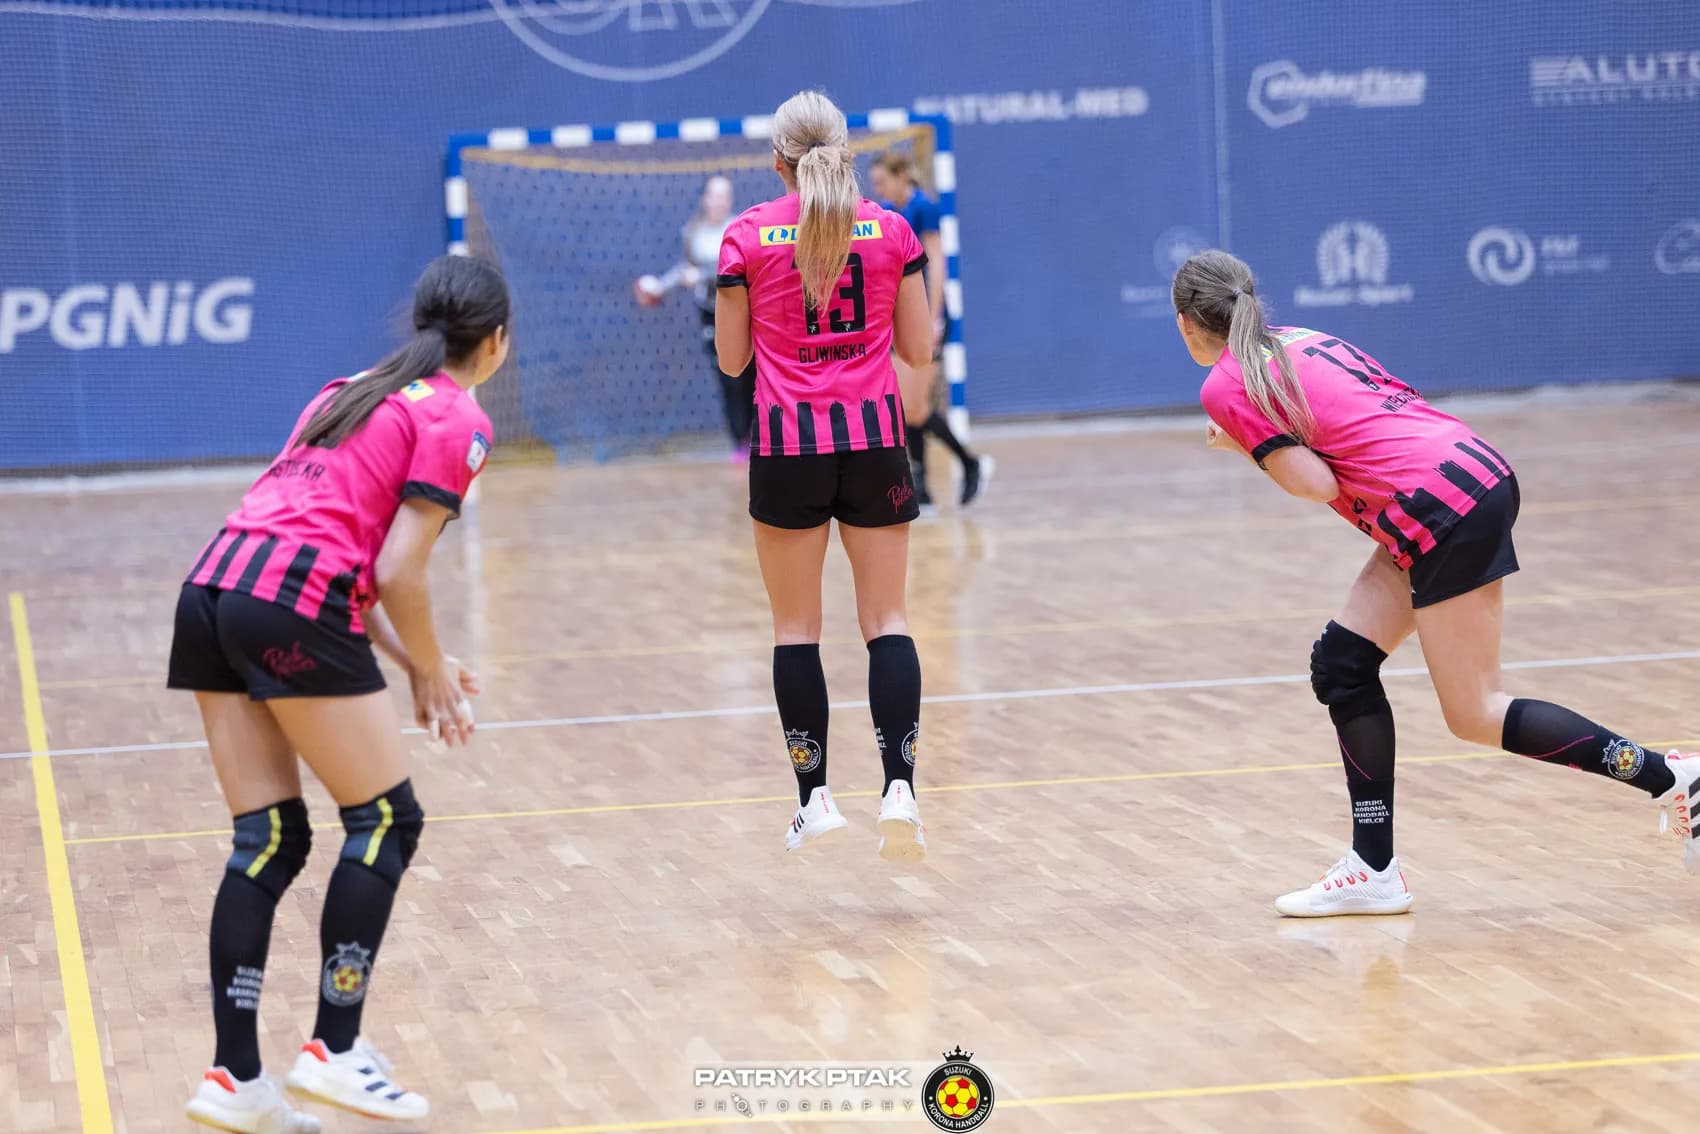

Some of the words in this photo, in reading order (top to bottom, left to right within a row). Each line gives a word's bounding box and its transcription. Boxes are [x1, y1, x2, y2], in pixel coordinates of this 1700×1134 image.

[0, 277, 254, 353] PGNiG
[1302, 338, 1392, 391] 17
[1355, 804, 1387, 812] KORONA
